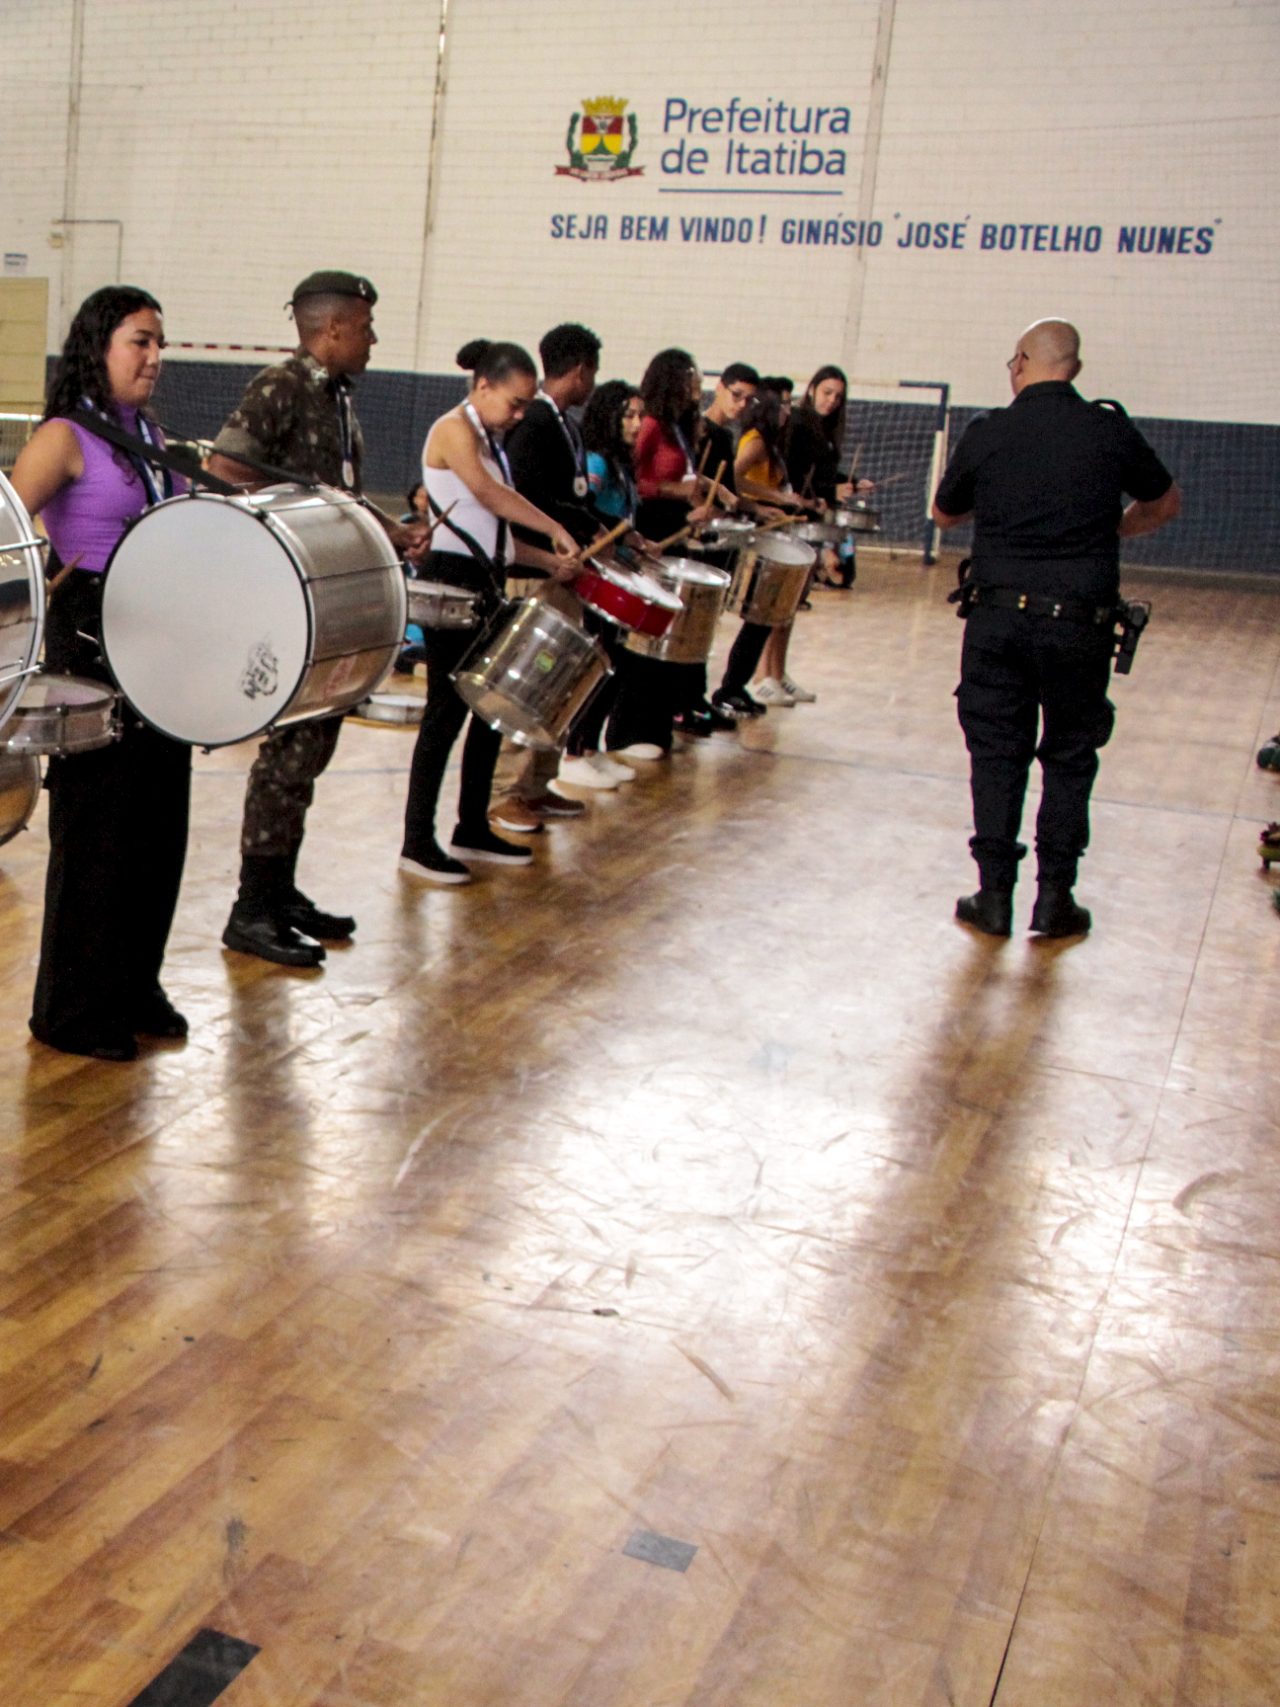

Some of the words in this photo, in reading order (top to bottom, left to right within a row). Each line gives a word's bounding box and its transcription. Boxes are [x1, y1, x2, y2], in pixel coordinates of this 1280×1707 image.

[663, 97, 852, 135] Prefeitura
[660, 138, 709, 175] de
[726, 138, 847, 176] Itatiba
[550, 213, 609, 240] SEJA
[619, 215, 669, 242] BEM
[679, 214, 767, 244] VINDO!
[781, 212, 883, 247] GINÁSIO
[980, 222, 1103, 252] BOTELHO
